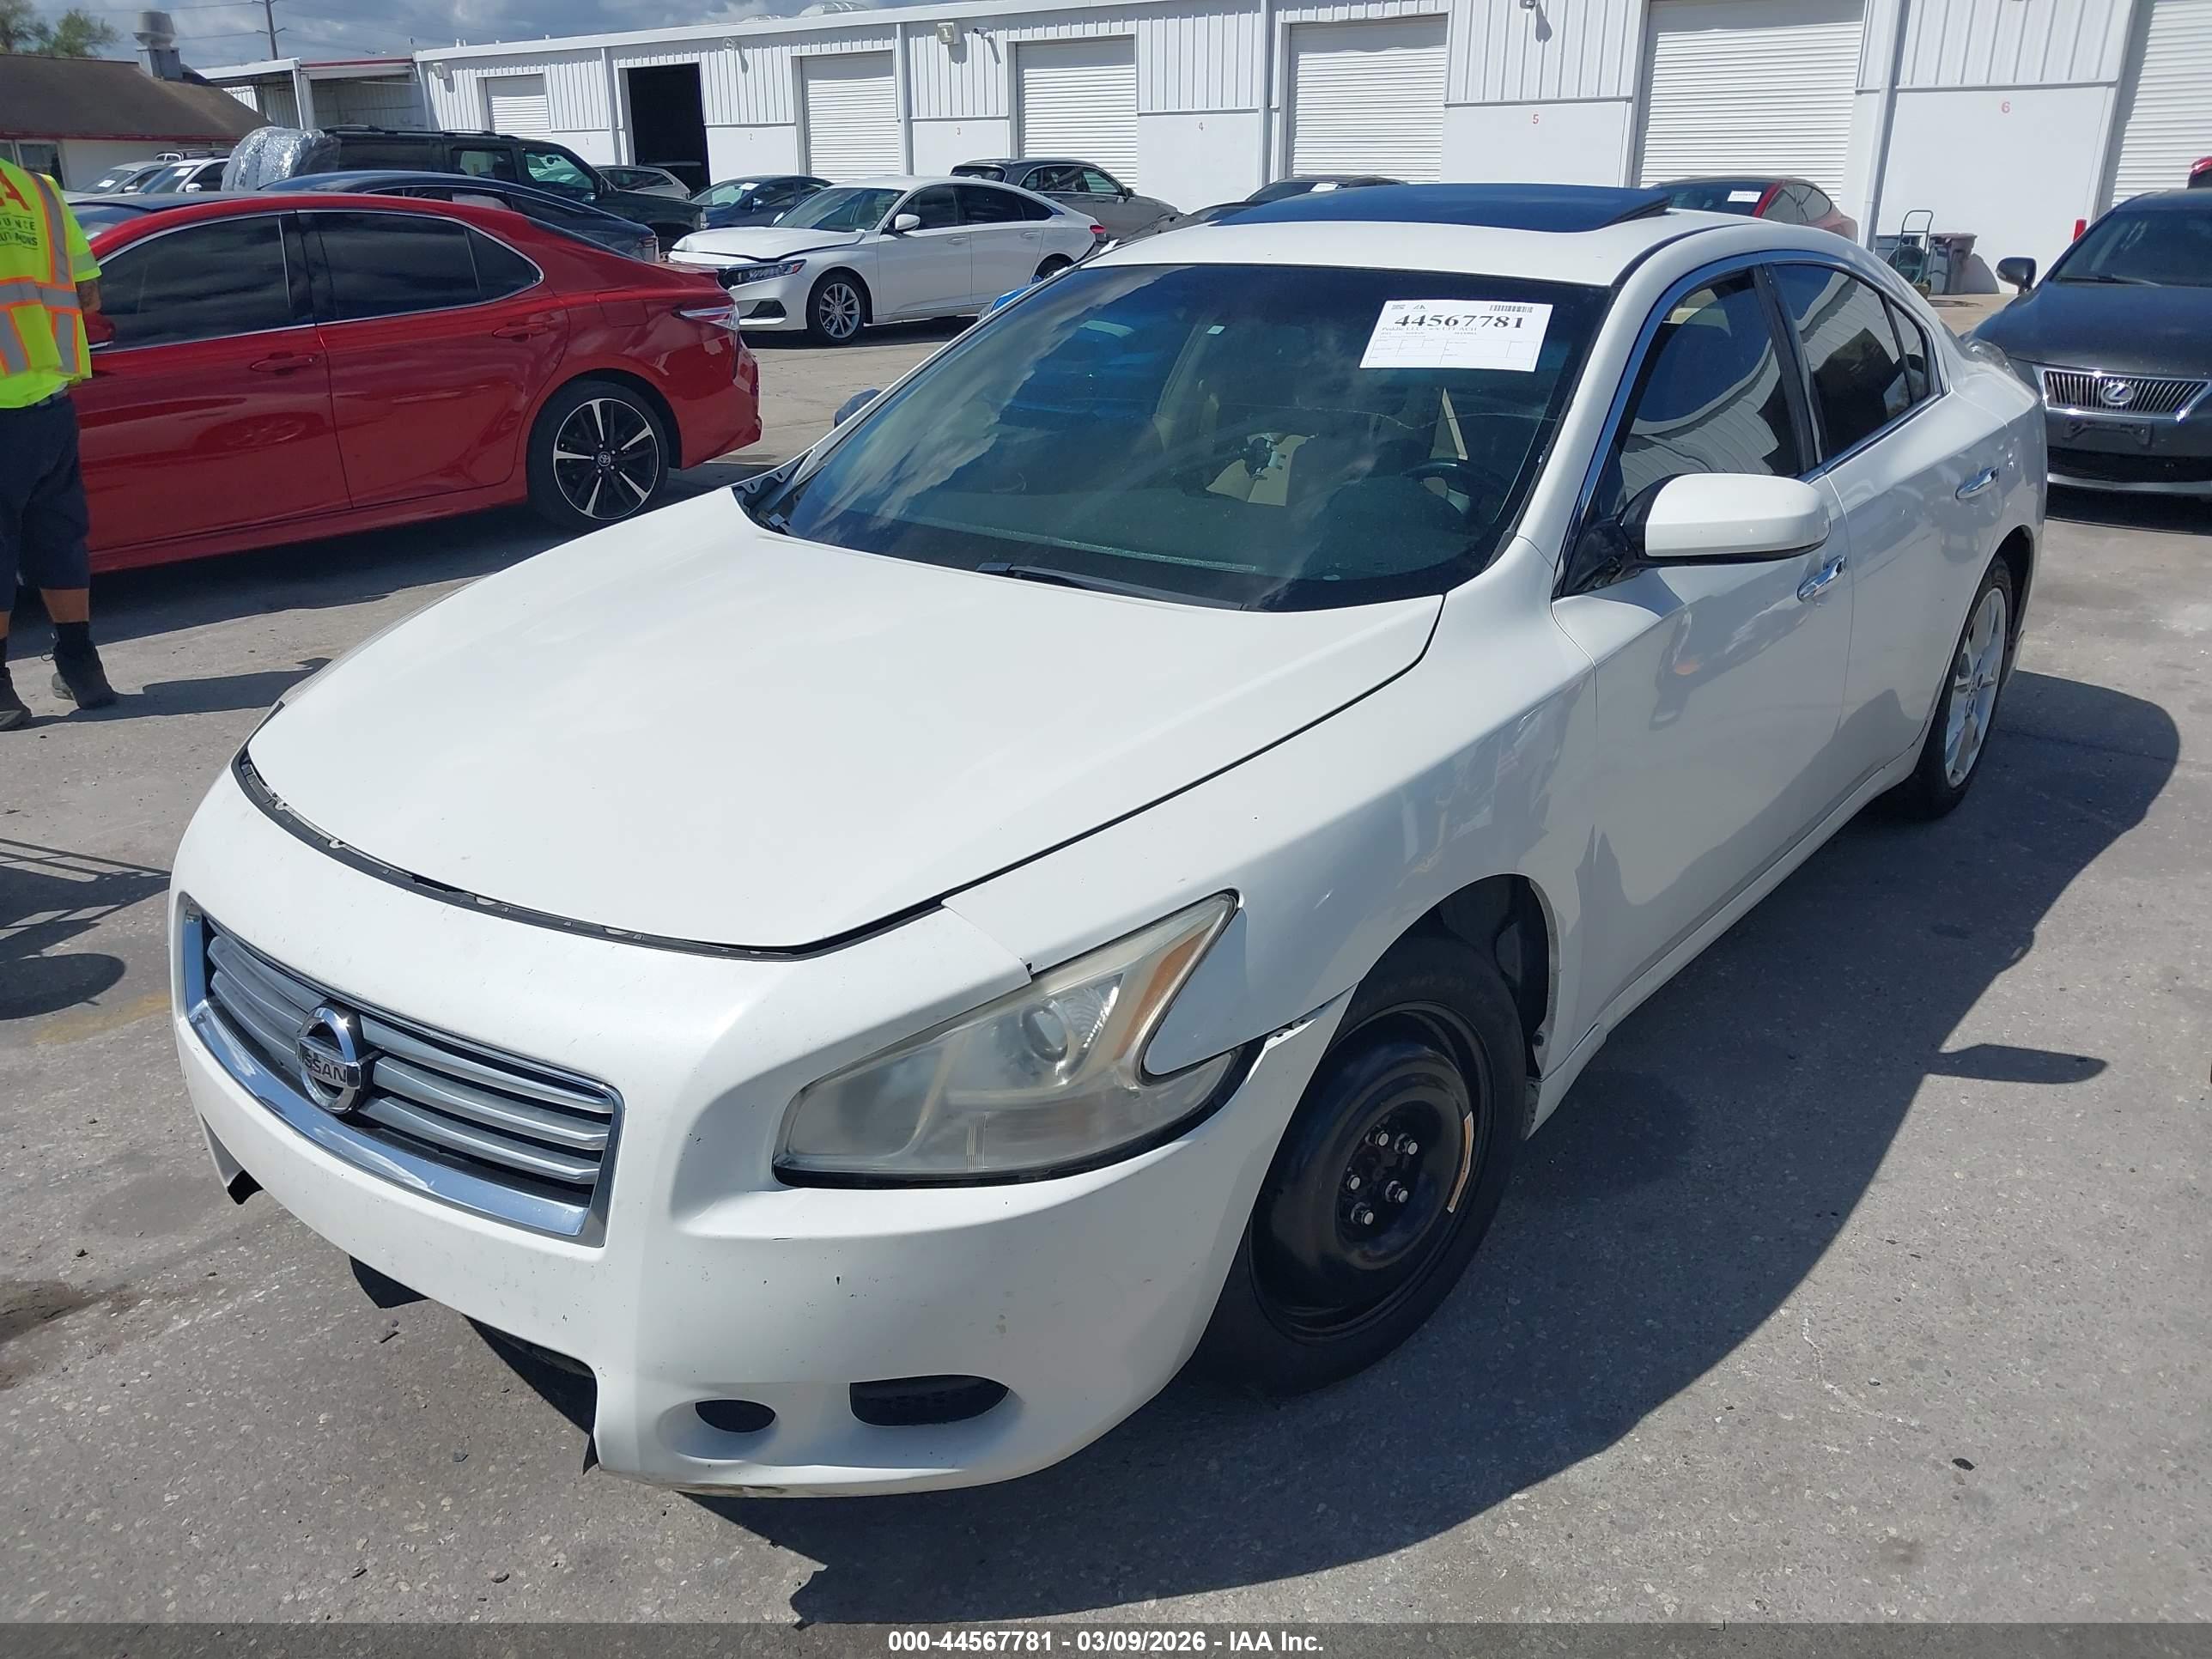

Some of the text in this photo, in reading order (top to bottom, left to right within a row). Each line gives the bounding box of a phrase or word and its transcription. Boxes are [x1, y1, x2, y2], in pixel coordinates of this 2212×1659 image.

[2001, 101, 2010, 113] 6
[1533, 113, 1539, 125] 5
[957, 127, 961, 136] 3
[1198, 122, 1204, 131] 4
[1395, 314, 1523, 329] 44567781
